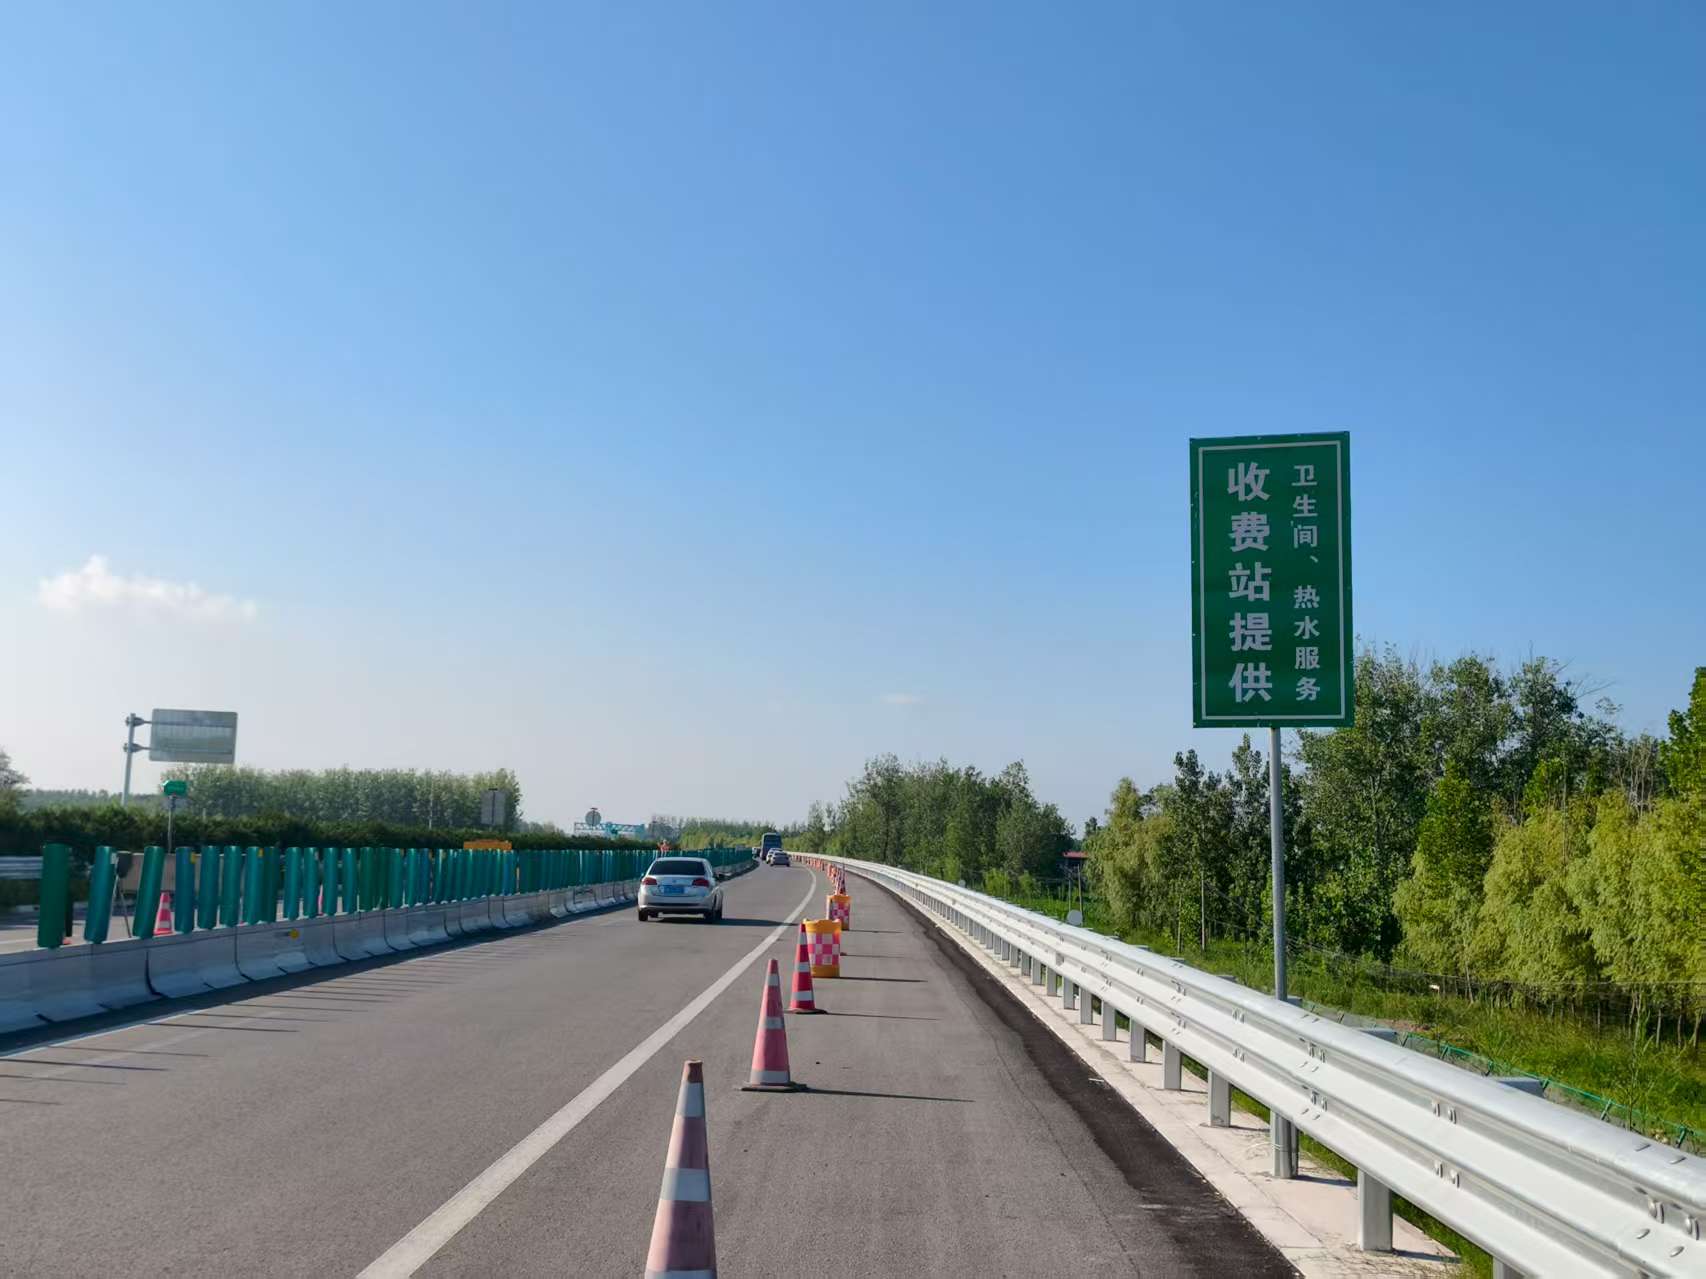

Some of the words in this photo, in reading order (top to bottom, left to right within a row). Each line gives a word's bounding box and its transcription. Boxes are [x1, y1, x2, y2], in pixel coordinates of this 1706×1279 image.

[1227, 462, 1273, 703] 收费站提供
